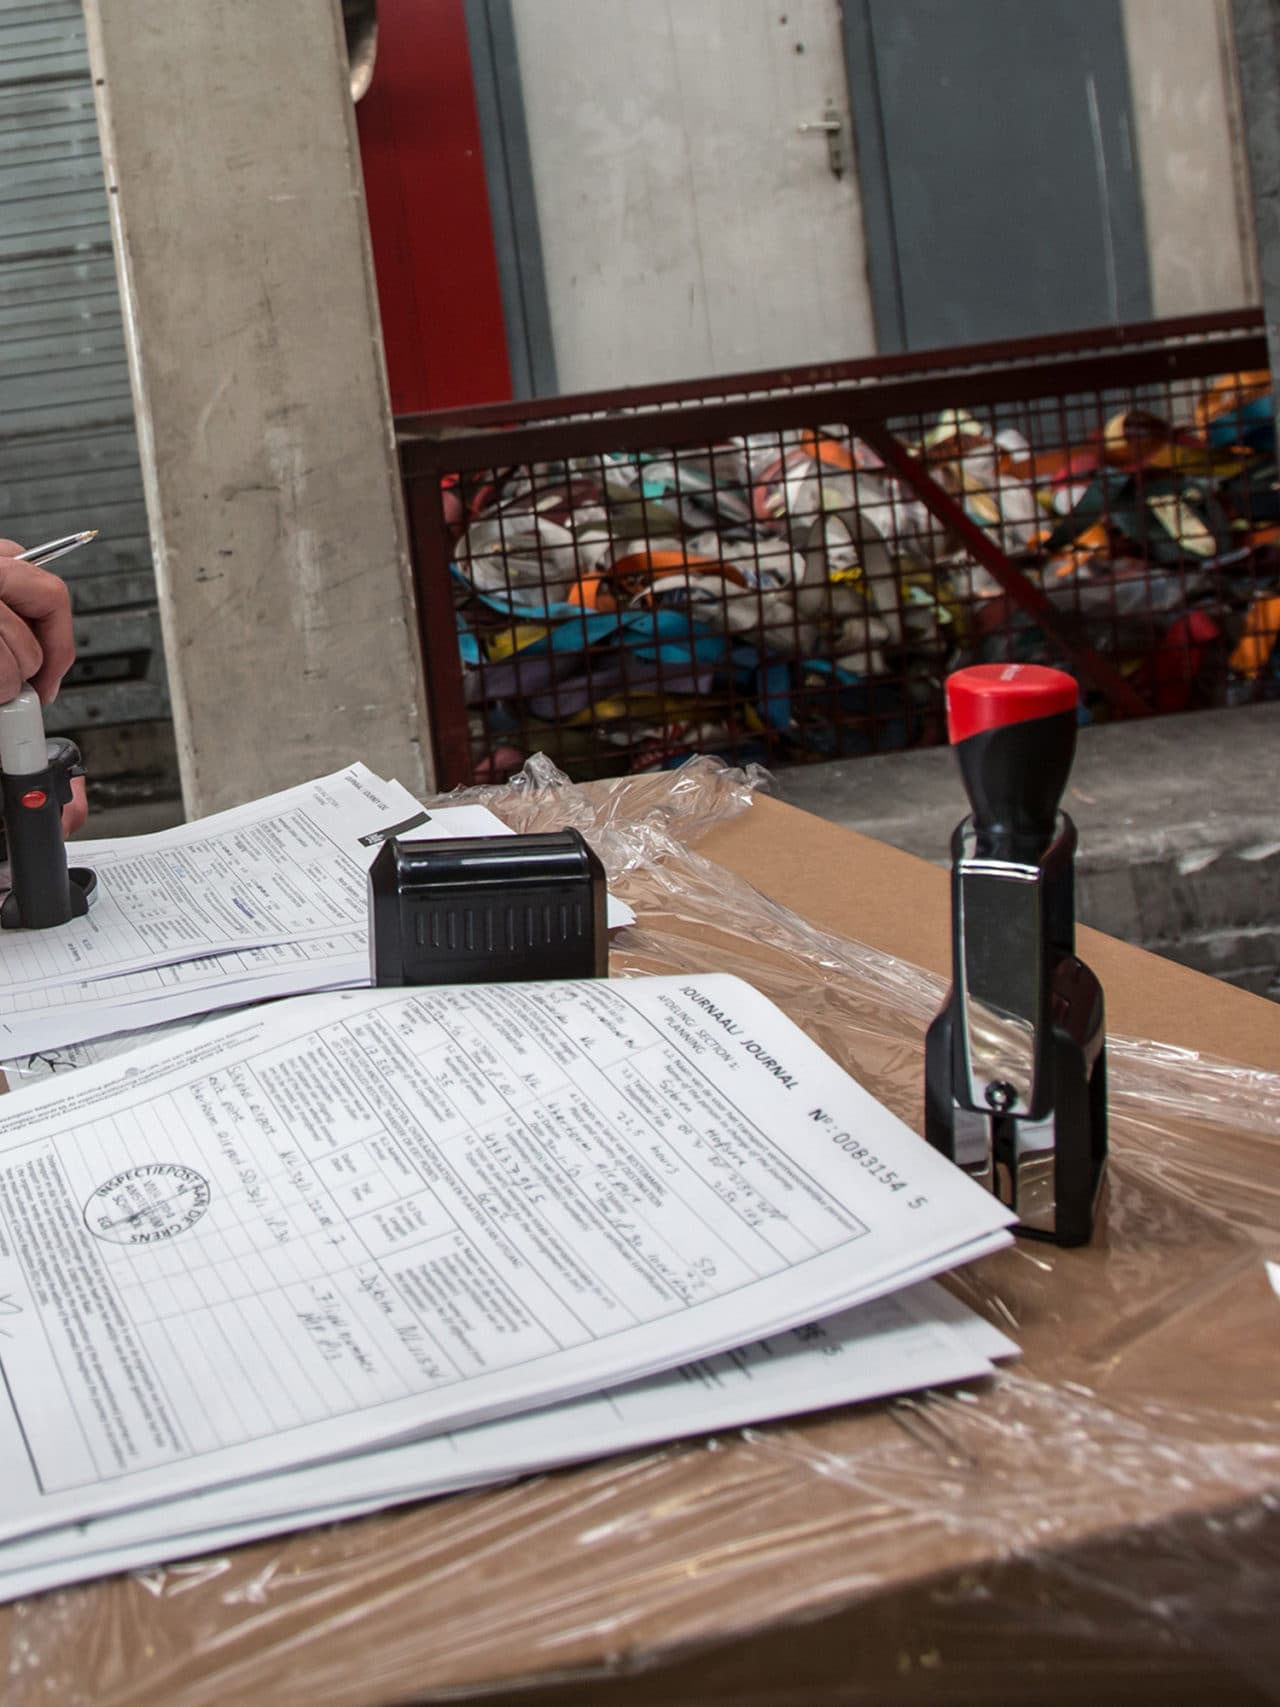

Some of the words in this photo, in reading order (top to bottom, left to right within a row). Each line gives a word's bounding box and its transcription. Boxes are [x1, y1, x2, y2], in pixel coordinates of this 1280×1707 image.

[664, 1015, 706, 1055] PLANNING
[679, 985, 744, 1036] JOURNAAL/
[740, 1039, 800, 1091] JOURNAL
[696, 1029, 733, 1063] SECTION
[95, 1165, 200, 1198] INSPECTIEPOST
[129, 1223, 183, 1244] GRENS
